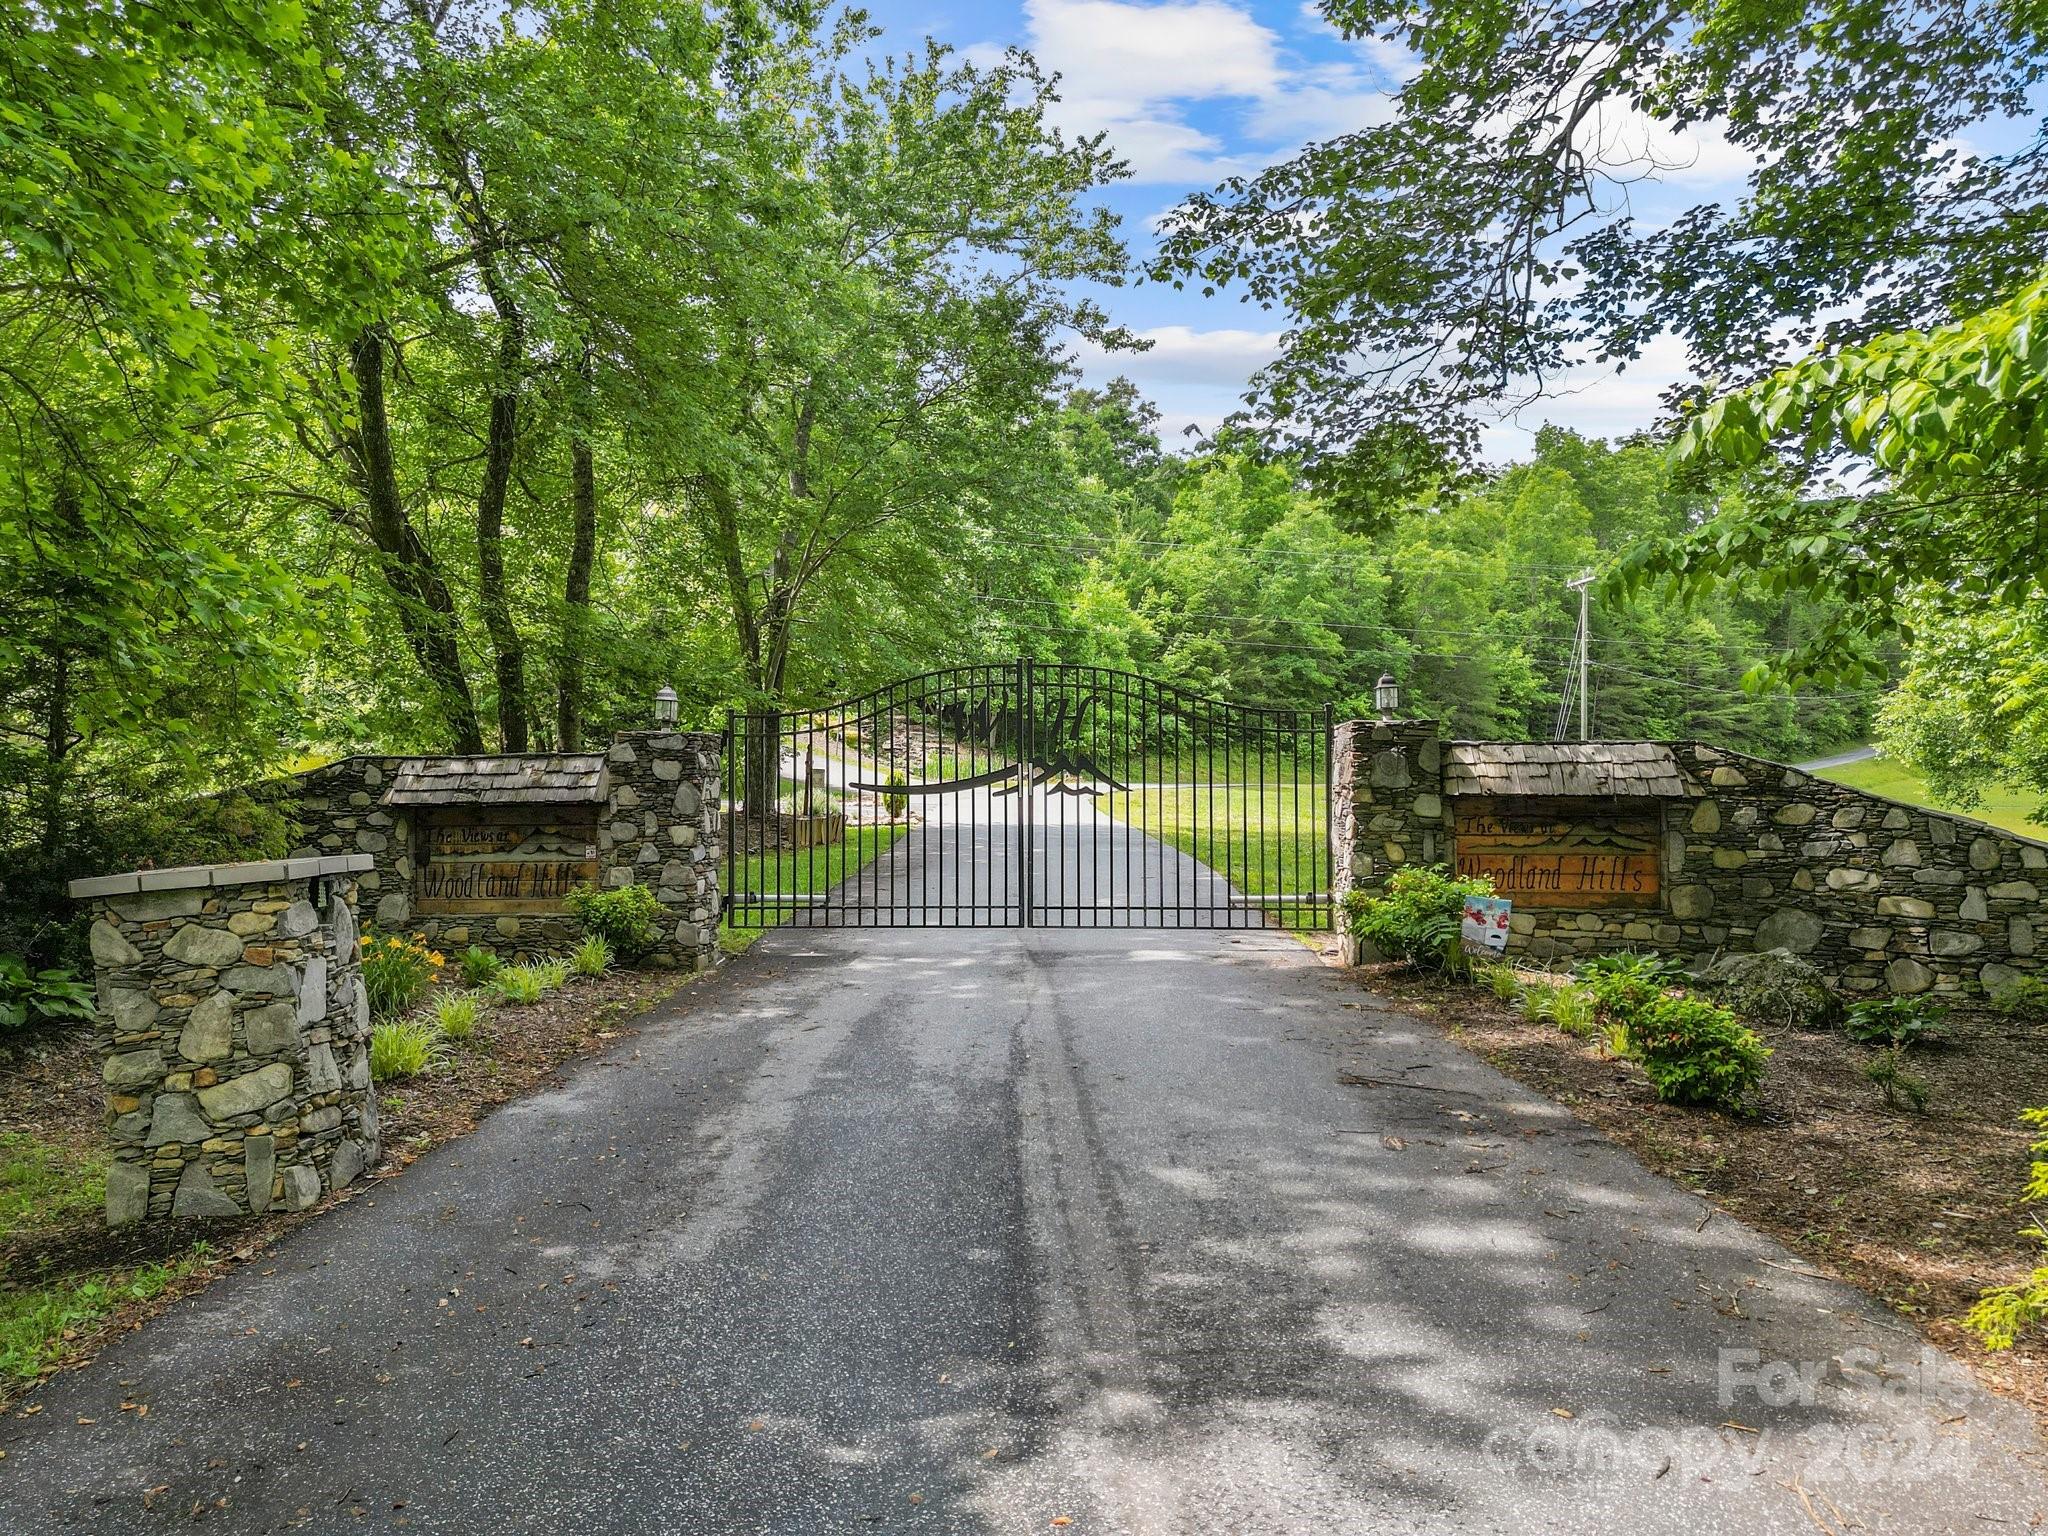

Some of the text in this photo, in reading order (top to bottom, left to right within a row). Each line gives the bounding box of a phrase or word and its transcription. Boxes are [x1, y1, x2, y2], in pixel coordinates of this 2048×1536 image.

[425, 827, 509, 843] The Views at
[1461, 815, 1494, 834] The
[1499, 816, 1534, 833] Views
[423, 863, 525, 898] Woodland
[1576, 856, 1642, 892] Hills
